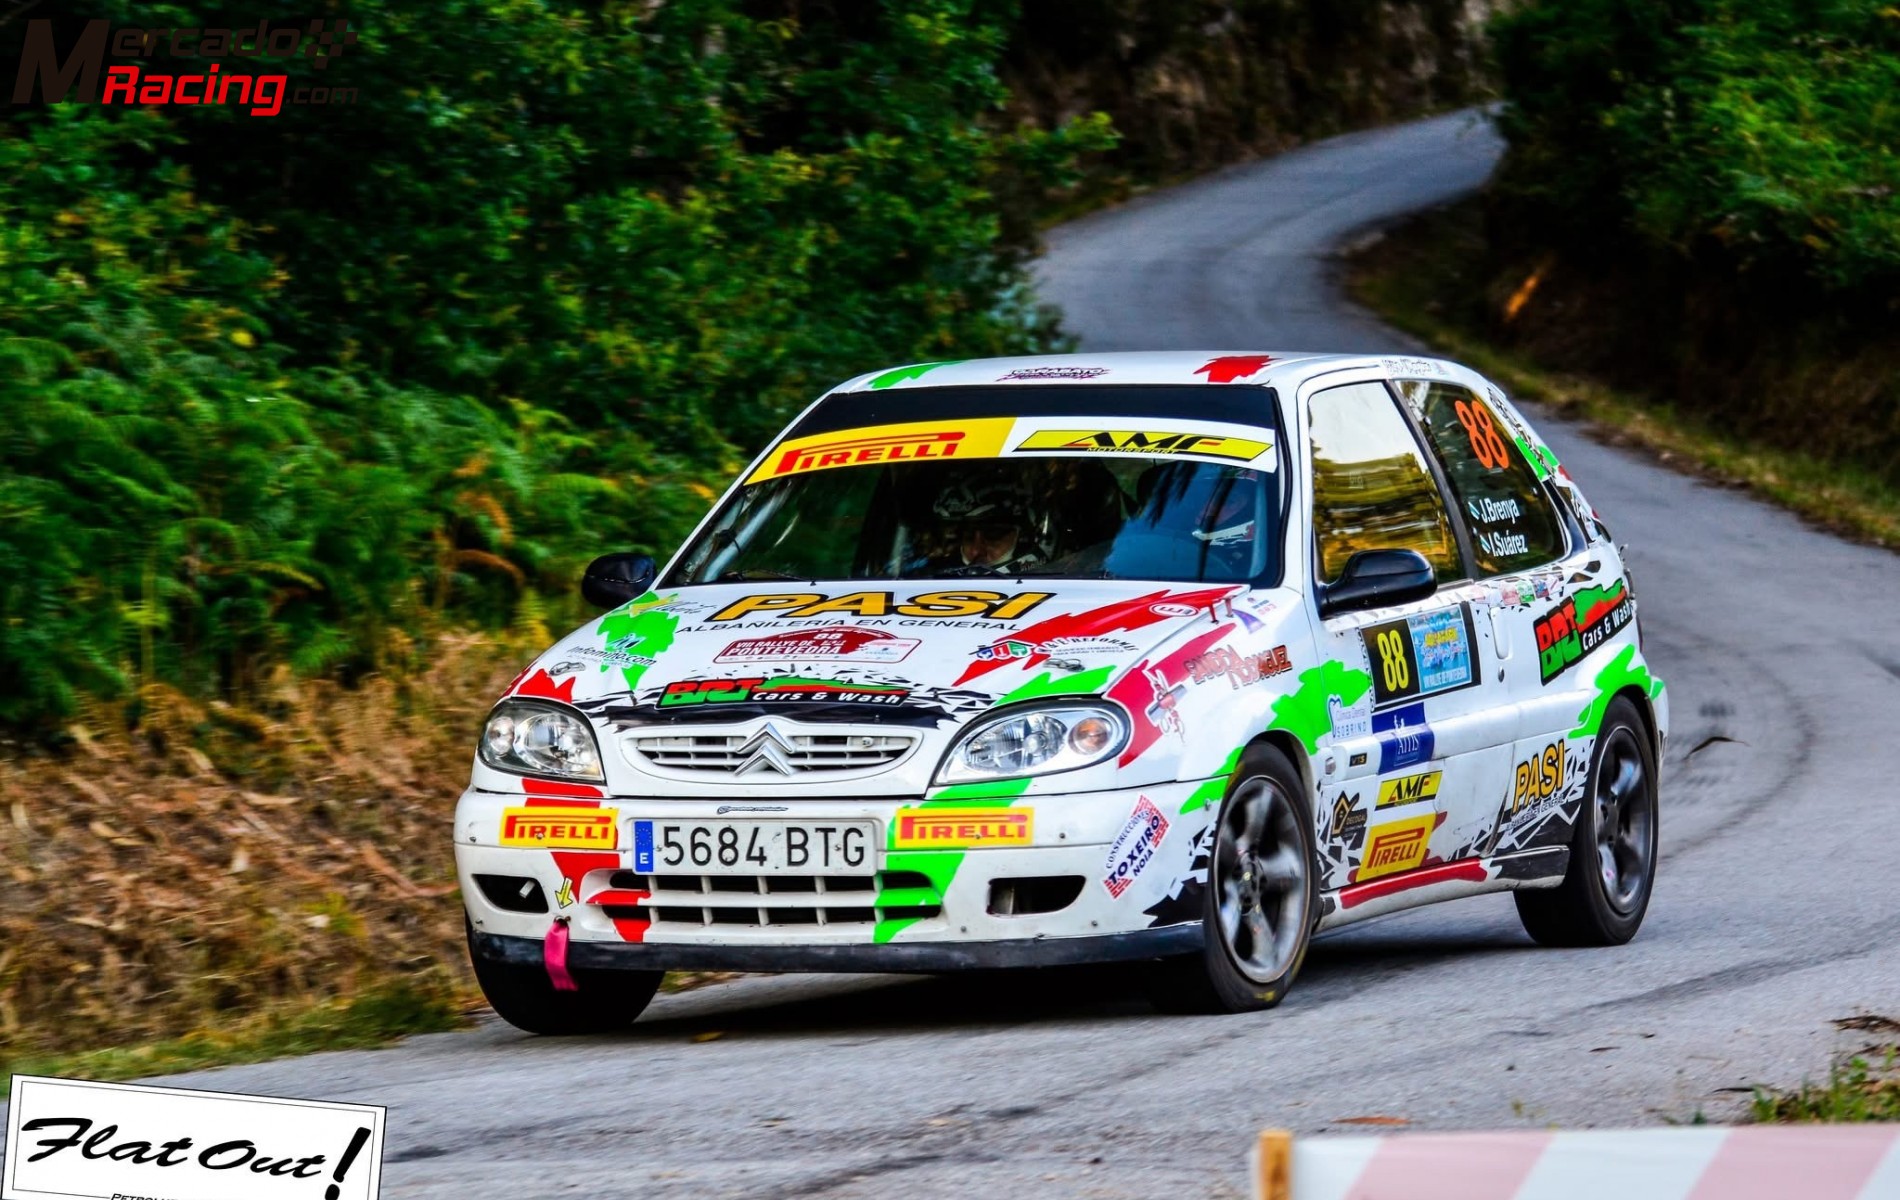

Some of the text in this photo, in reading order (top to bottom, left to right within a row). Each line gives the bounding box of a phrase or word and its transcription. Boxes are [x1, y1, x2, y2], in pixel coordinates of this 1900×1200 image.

[1061, 432, 1226, 450] AMF
[1454, 400, 1510, 469] 88
[774, 432, 965, 475] PIRELLI
[1480, 498, 1520, 524] J.Brenya
[1490, 530, 1528, 556] I.Suárez
[702, 591, 1057, 622] PASI
[856, 619, 890, 627] EN
[899, 619, 1021, 631] GENERAL
[1583, 626, 1603, 650] Cars
[1604, 617, 1611, 634] &
[727, 646, 841, 656] PONTEVEDRA
[1377, 629, 1409, 692] 88
[752, 691, 803, 701] Cars
[812, 691, 829, 700] &
[837, 692, 900, 704] Wash
[1388, 775, 1431, 802] AMF
[1511, 738, 1565, 817] PASI
[504, 815, 612, 840] PIRELLI
[900, 814, 1028, 840] PIRELLI
[639, 852, 649, 864] E
[663, 825, 865, 867] 5684 BTG
[1109, 815, 1160, 885] TOXEIRO
[1367, 827, 1425, 869] PIRELLI
[1133, 849, 1154, 877] NOIA
